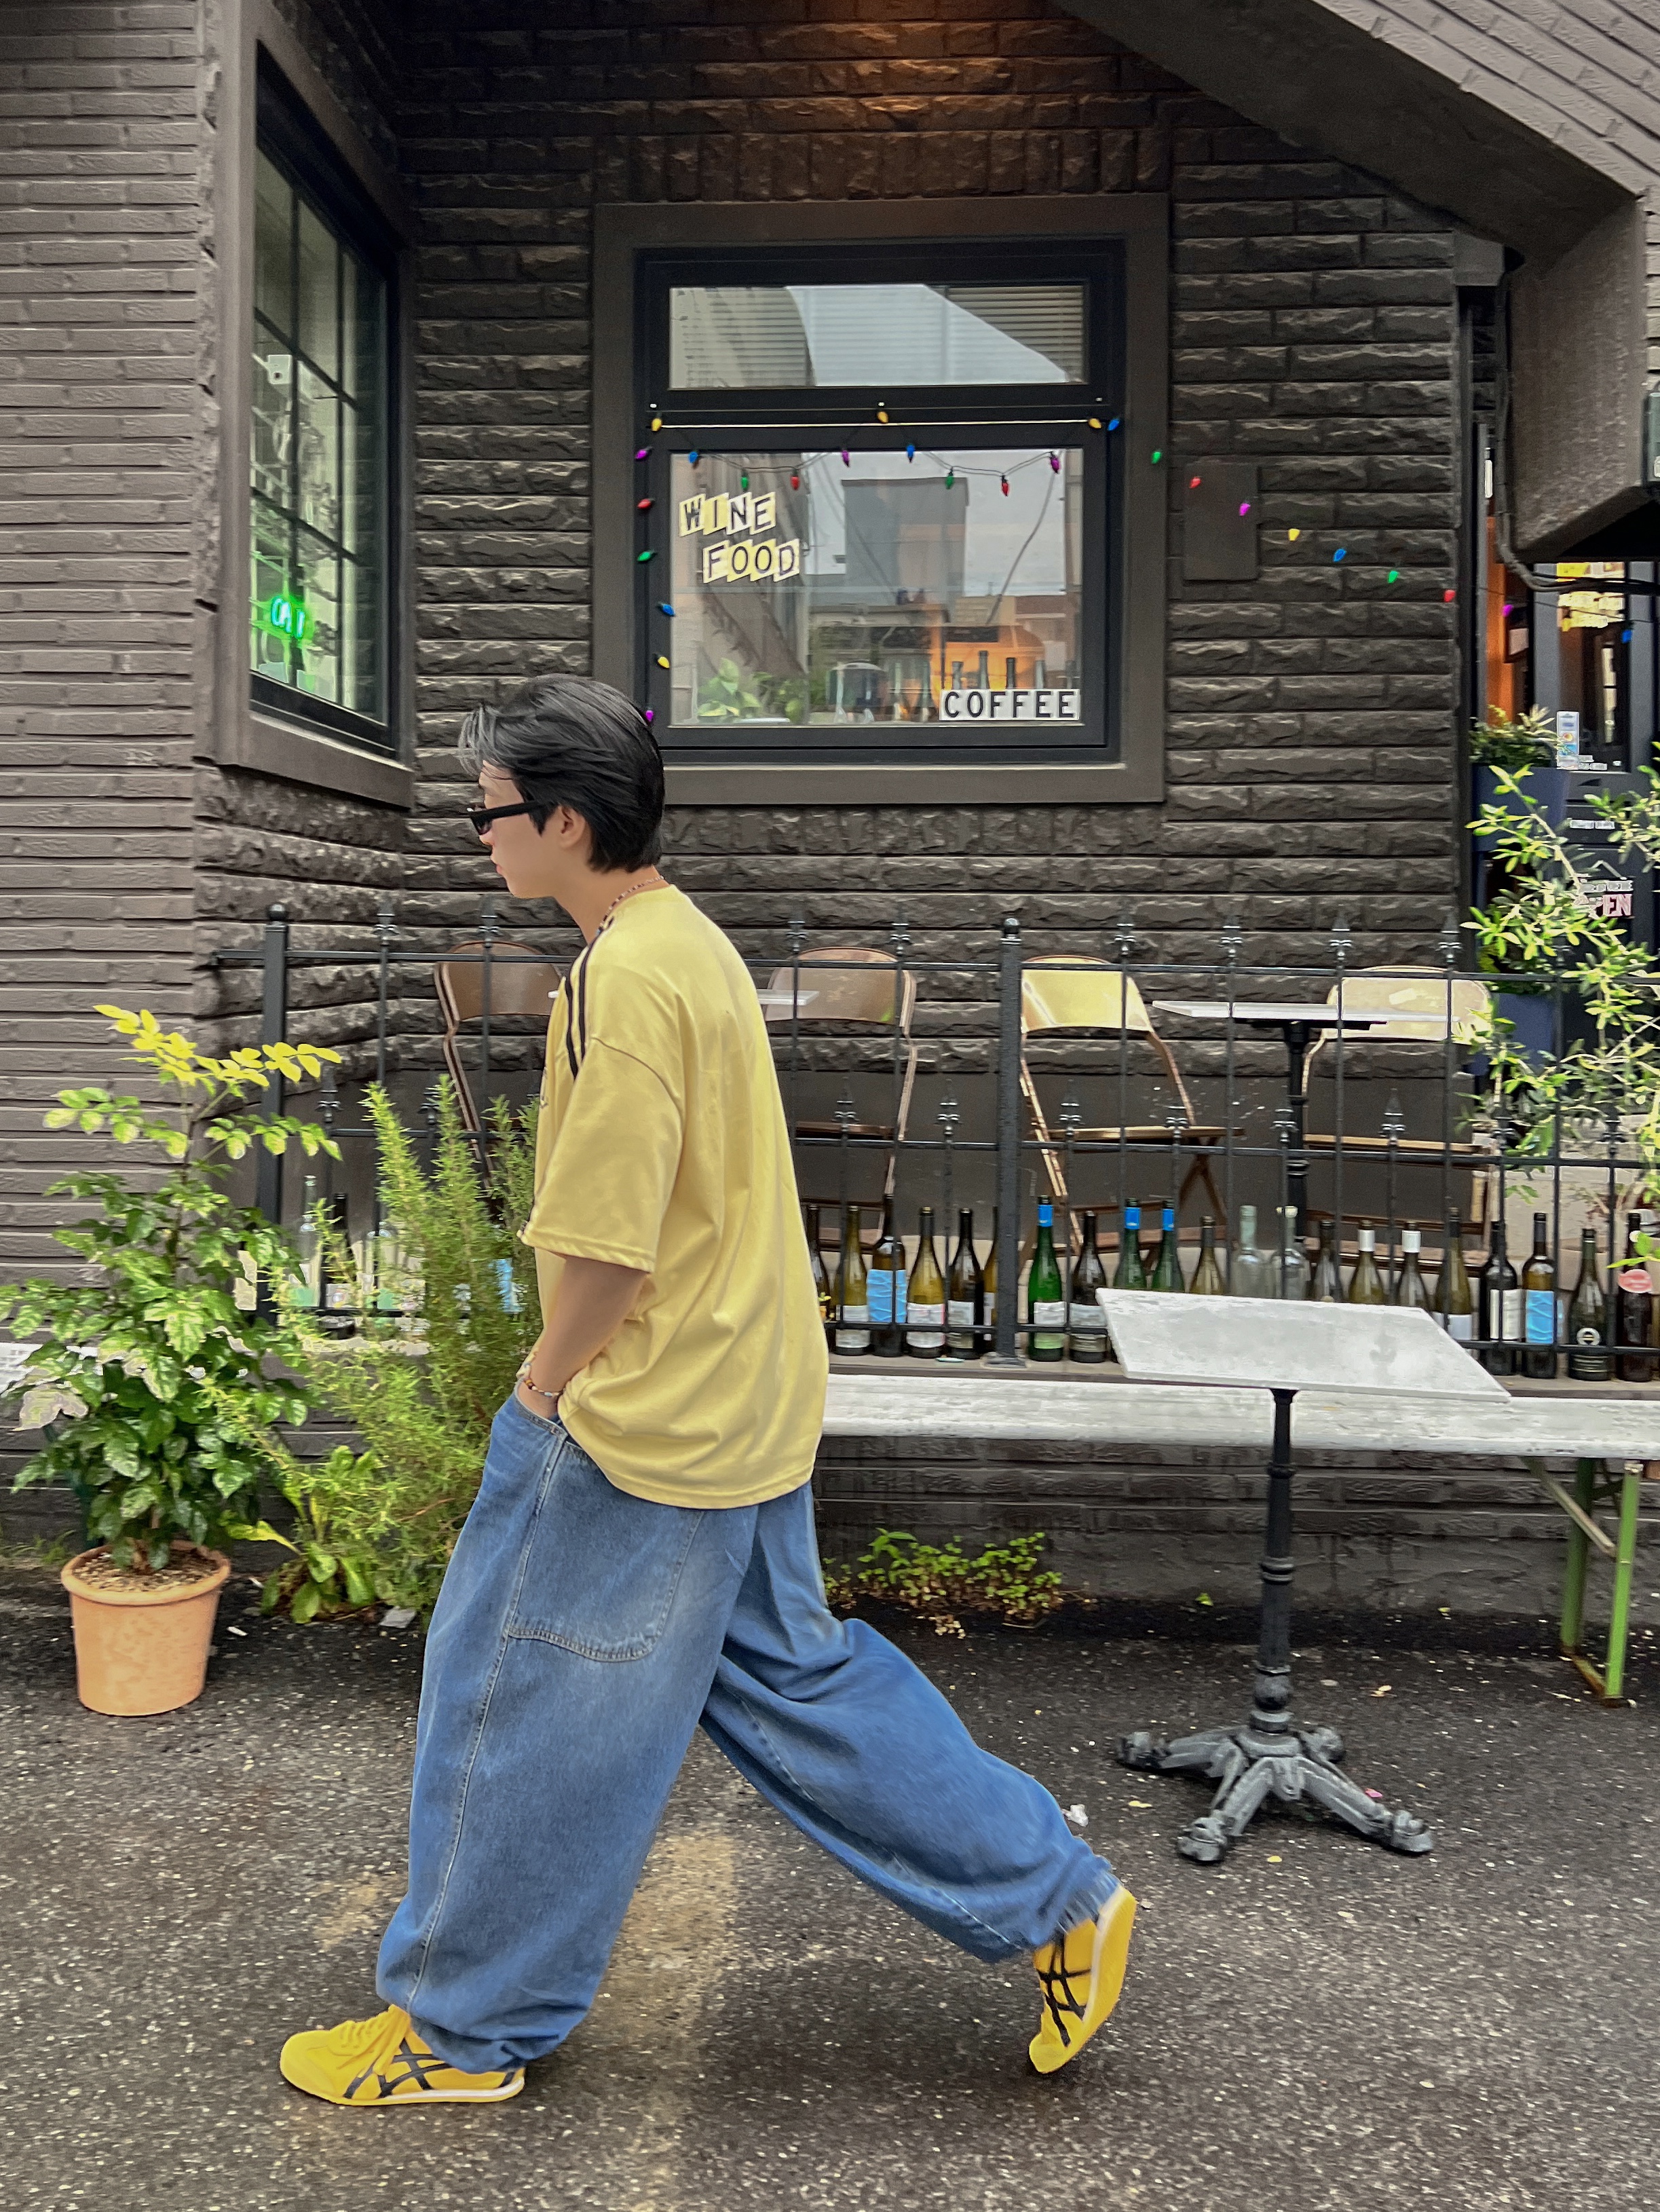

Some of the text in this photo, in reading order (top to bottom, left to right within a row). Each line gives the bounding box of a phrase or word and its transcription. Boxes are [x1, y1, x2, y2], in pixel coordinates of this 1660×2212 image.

[683, 496, 772, 531] WINE
[708, 544, 795, 578] FOOD
[944, 690, 1075, 718] COFFEE
